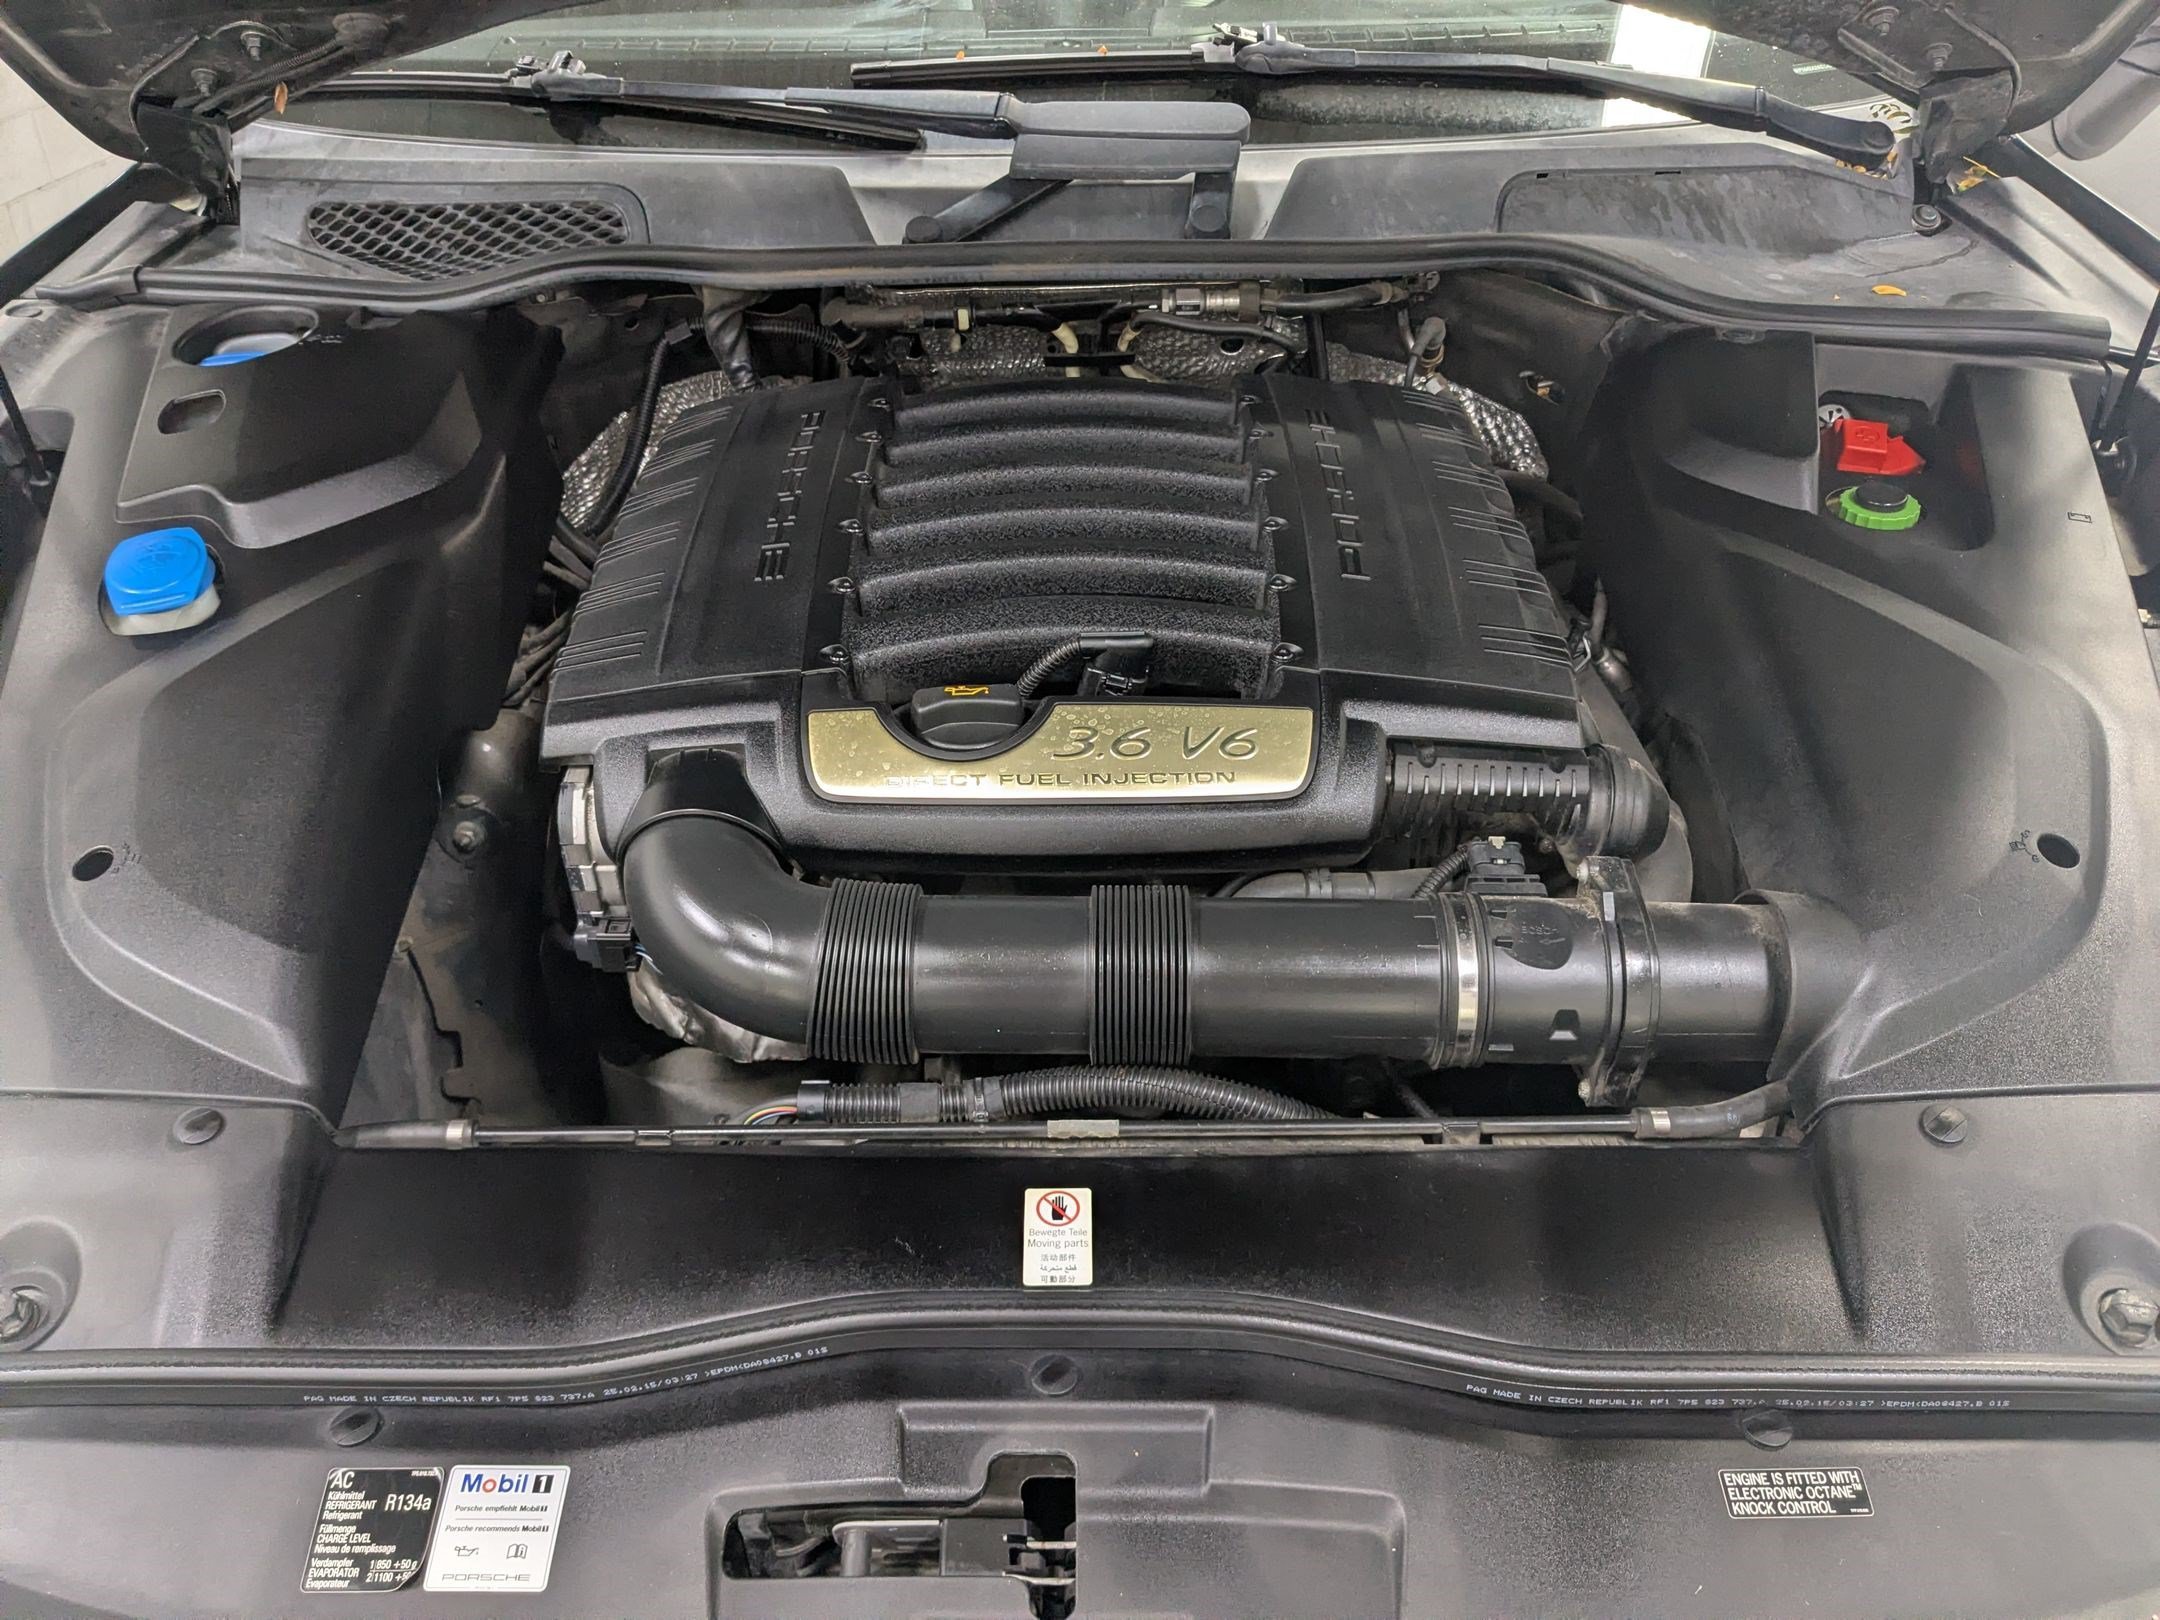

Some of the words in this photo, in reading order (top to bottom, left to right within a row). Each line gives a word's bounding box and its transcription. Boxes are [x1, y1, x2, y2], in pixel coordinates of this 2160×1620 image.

[1051, 725, 1152, 761] 3.6
[1181, 725, 1259, 761] V6
[885, 774, 987, 788] DIRECT
[1000, 773, 1070, 787] FUEL
[1083, 771, 1236, 786] INJECTION
[1028, 1228, 1066, 1237] Bewegte
[1069, 1228, 1088, 1236] Teile
[1027, 1239, 1061, 1249] Moving
[1064, 1239, 1089, 1249] parts
[1466, 1384, 1487, 1394] PAG
[1493, 1388, 1521, 1400] MADE
[1529, 1394, 1542, 1402] IN
[1548, 1396, 1583, 1405] CZECH
[1589, 1398, 1643, 1406] REPUBLIK
[331, 1471, 355, 1488] AC
[1723, 1472, 1770, 1486] ENGINE
[1772, 1471, 1784, 1485] IS
[1785, 1471, 1826, 1485] FITTED
[1828, 1470, 1860, 1484] WITH
[460, 1474, 529, 1493] Mobil
[327, 1491, 365, 1500] Kühlmittel
[1727, 1486, 1804, 1501] ELECTRONIC
[325, 1500, 377, 1510] REFRIGERANT
[385, 1494, 432, 1511] R134a
[1731, 1501, 1776, 1515] KNOCK
[1777, 1500, 1837, 1514] CONTROL
[485, 1505, 517, 1513] empfiehlt
[322, 1511, 363, 1521] Refrigerant
[319, 1524, 356, 1534] Füllmenge
[317, 1534, 348, 1543] CHARGE
[349, 1533, 371, 1543] LEVEL
[314, 1544, 340, 1553] Niveau
[341, 1544, 350, 1553] de
[351, 1544, 396, 1555] remplissage
[311, 1558, 354, 1568] Verdampfer
[308, 1568, 360, 1578] EVAPORATOR
[306, 1579, 350, 1589] Evaporateur
